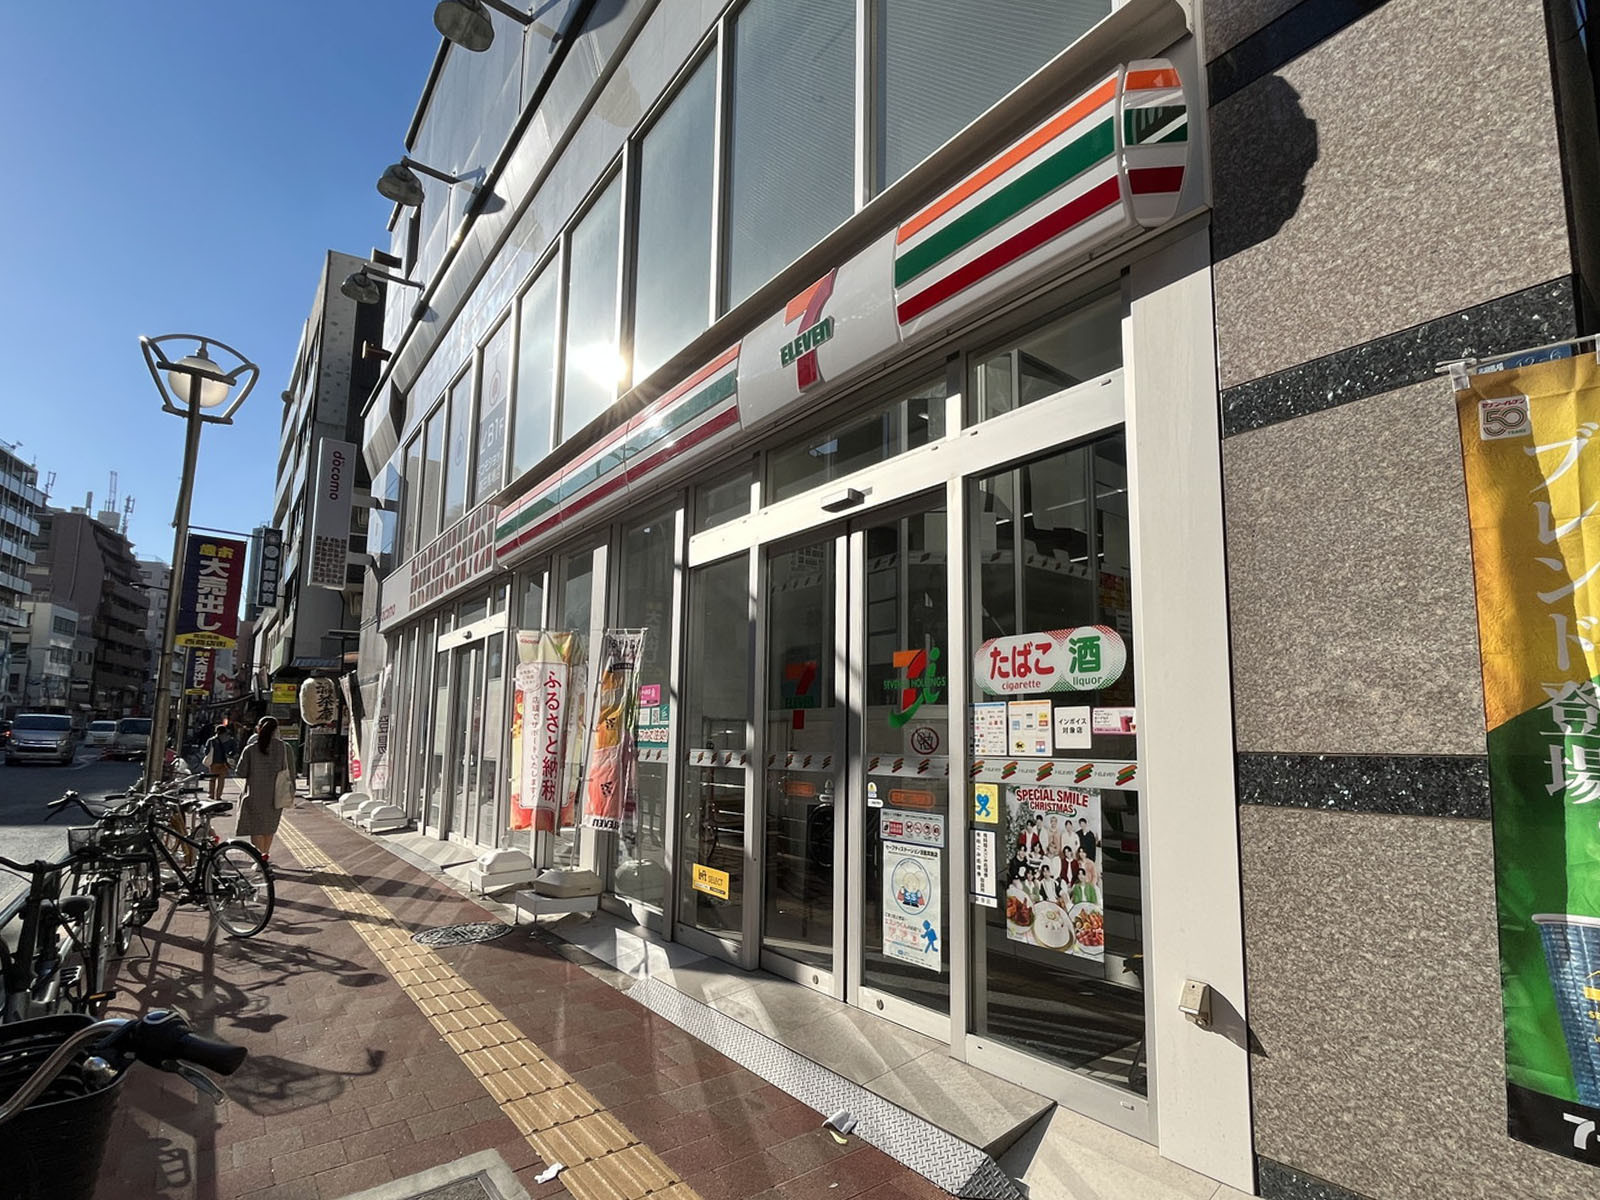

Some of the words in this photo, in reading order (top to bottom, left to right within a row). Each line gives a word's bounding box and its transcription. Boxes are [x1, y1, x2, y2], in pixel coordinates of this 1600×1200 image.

[1483, 406, 1527, 436] 50
[329, 450, 345, 501] docomo
[195, 557, 231, 631] 大売出し
[1523, 422, 1600, 804] ブレンド登場
[990, 641, 1055, 680] たばこ
[1068, 635, 1101, 673] 酒
[1001, 680, 1041, 691] cigarette
[1072, 676, 1103, 687] liquor
[1058, 717, 1087, 725] インボイス
[1062, 726, 1083, 734] 対象店
[542, 671, 562, 802] ふるさと納税
[1016, 788, 1055, 803] SPECIAL
[1056, 789, 1089, 808] SMILE
[1029, 801, 1074, 813] CHRISTMAS
